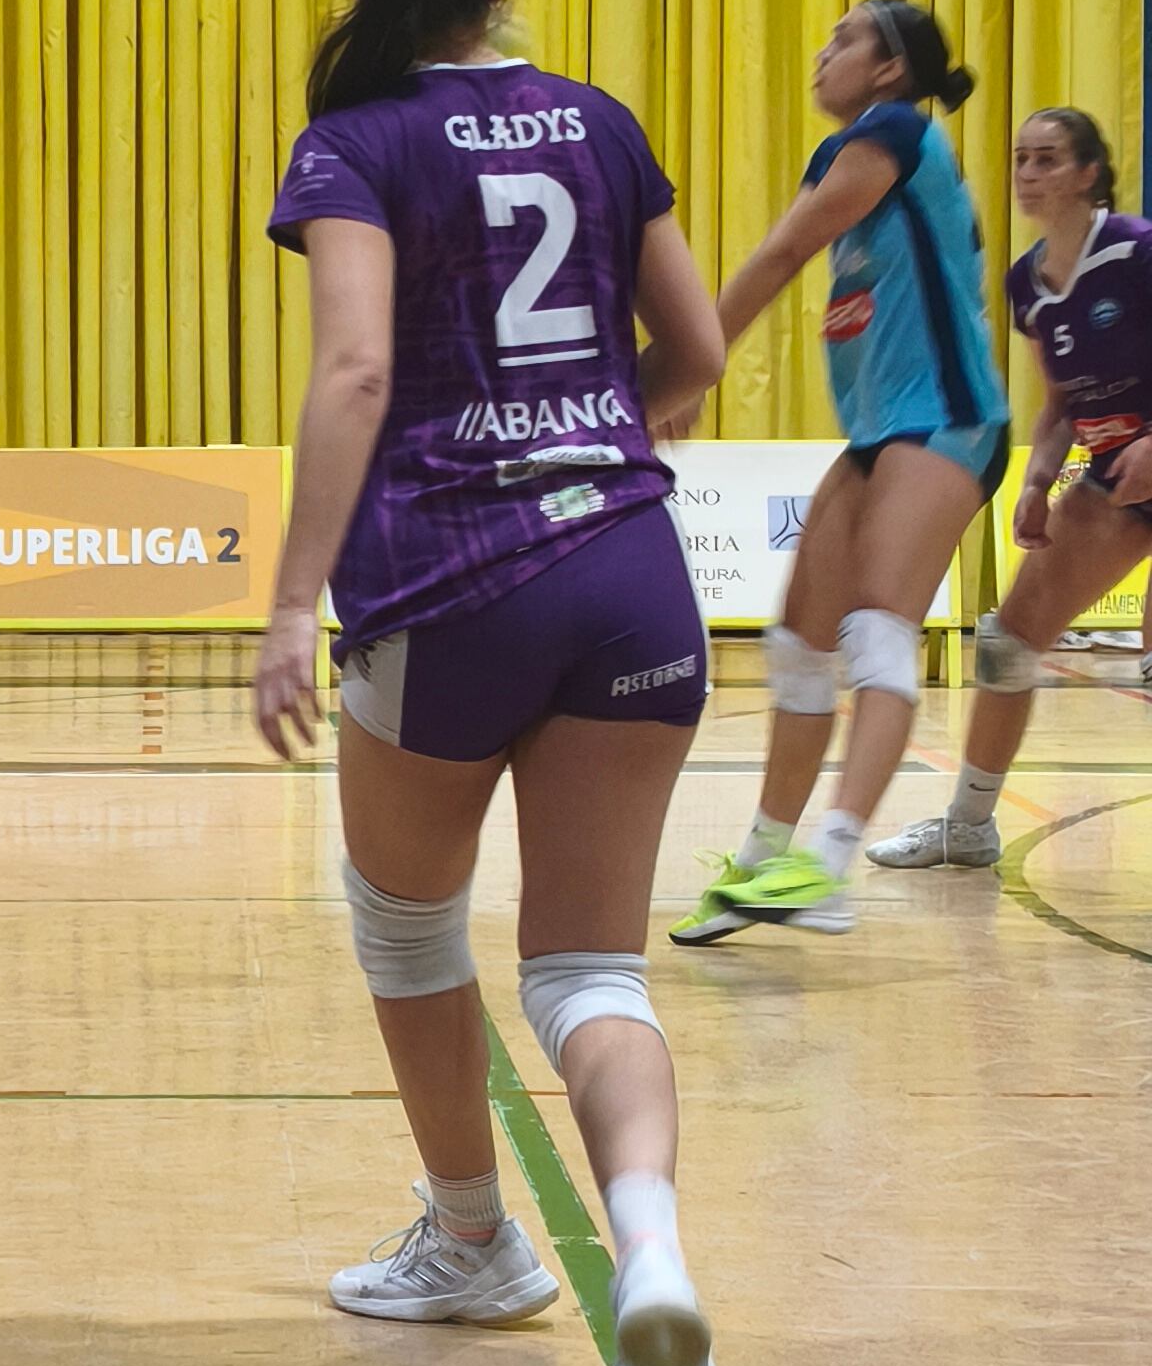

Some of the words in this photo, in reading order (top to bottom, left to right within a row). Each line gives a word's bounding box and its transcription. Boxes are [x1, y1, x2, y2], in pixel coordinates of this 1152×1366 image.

[445, 107, 587, 151] GLADYS
[477, 172, 598, 348] 2
[1054, 324, 1075, 357] 5
[217, 527, 242, 563] 2
